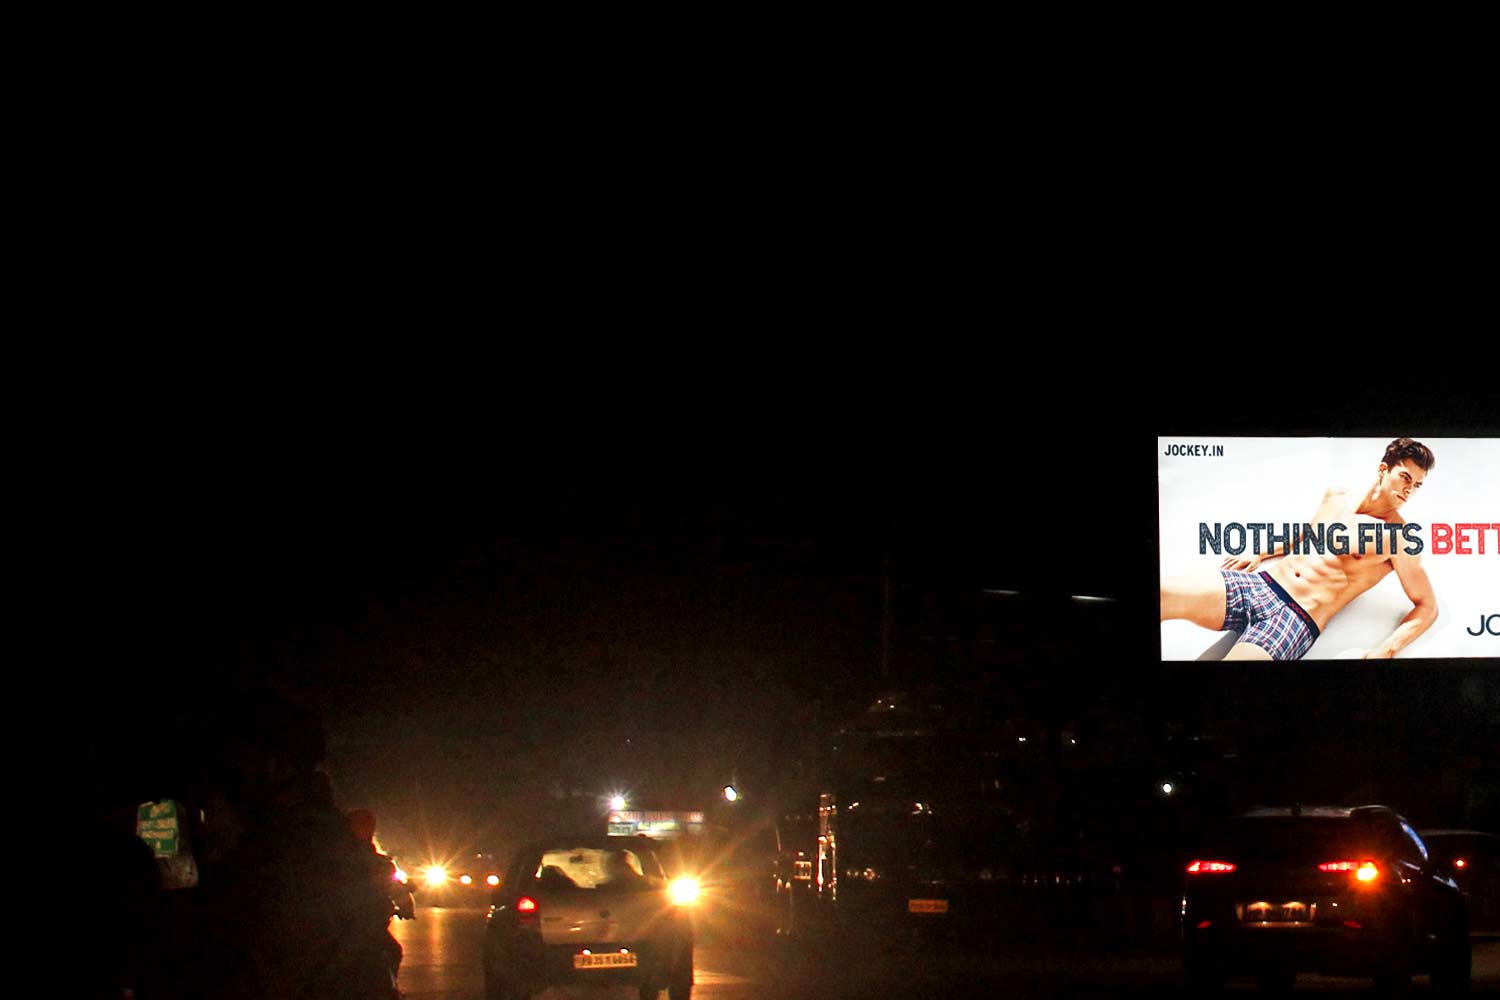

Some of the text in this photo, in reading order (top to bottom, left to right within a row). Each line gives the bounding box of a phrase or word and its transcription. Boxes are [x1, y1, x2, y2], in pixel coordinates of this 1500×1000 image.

[1164, 444, 1224, 457] JOCKEY.IN
[1199, 522, 1350, 555] NOTHING
[1357, 522, 1424, 555] FITS
